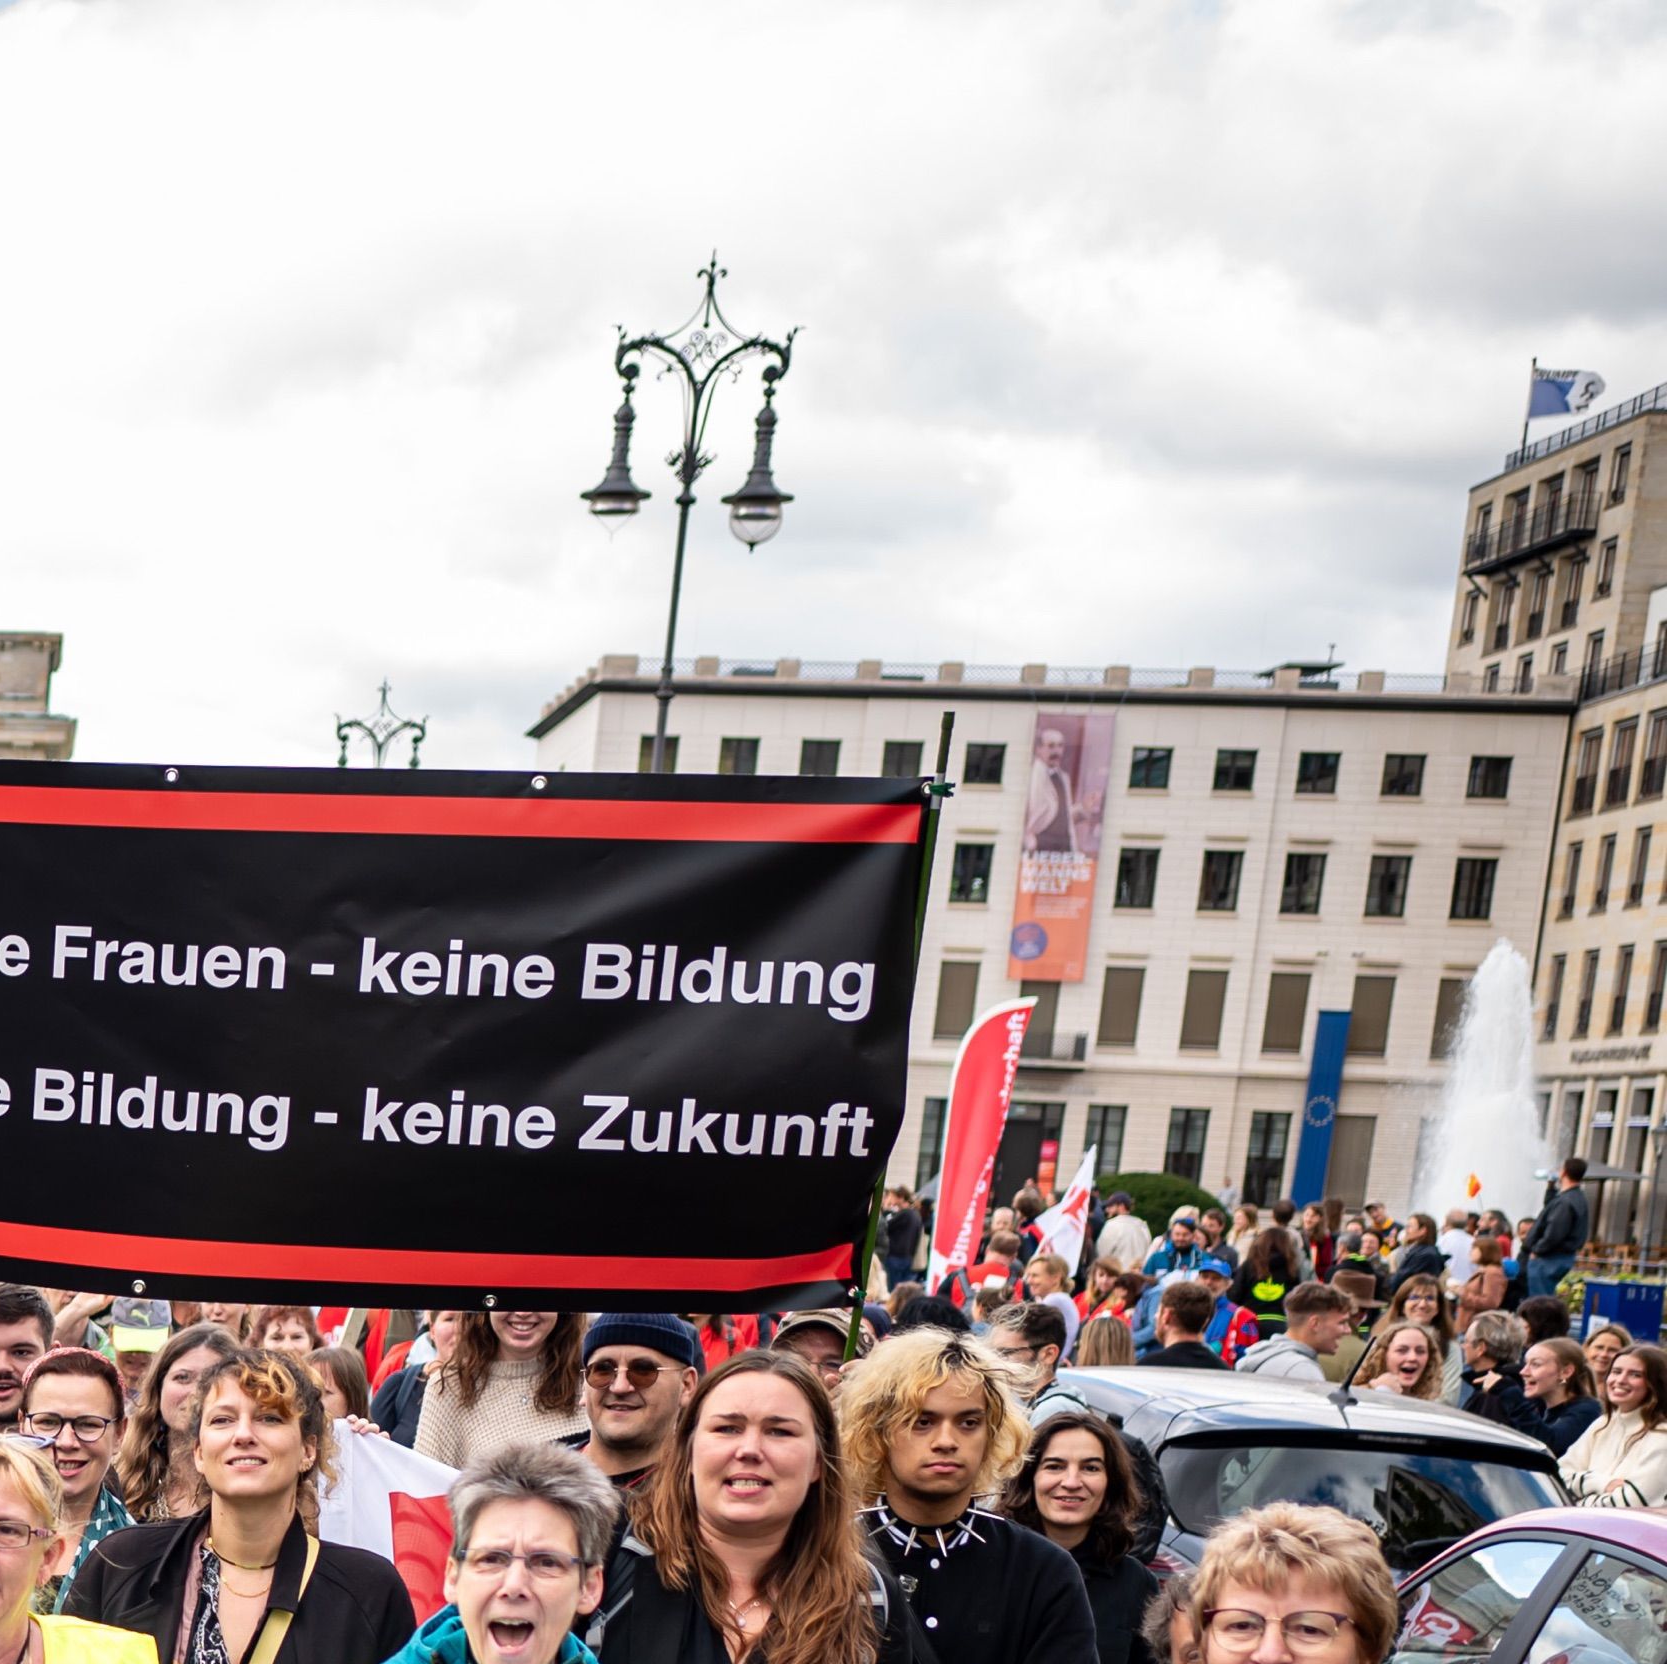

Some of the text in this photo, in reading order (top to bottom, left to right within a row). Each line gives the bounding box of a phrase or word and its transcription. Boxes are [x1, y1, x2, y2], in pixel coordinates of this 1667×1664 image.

[52, 925, 287, 990] Frauen
[359, 937, 555, 1000] keine
[581, 943, 875, 1022] Bildung
[33, 1067, 290, 1151] Bildung
[362, 1087, 556, 1149] keine
[578, 1094, 874, 1157] Zukunft
